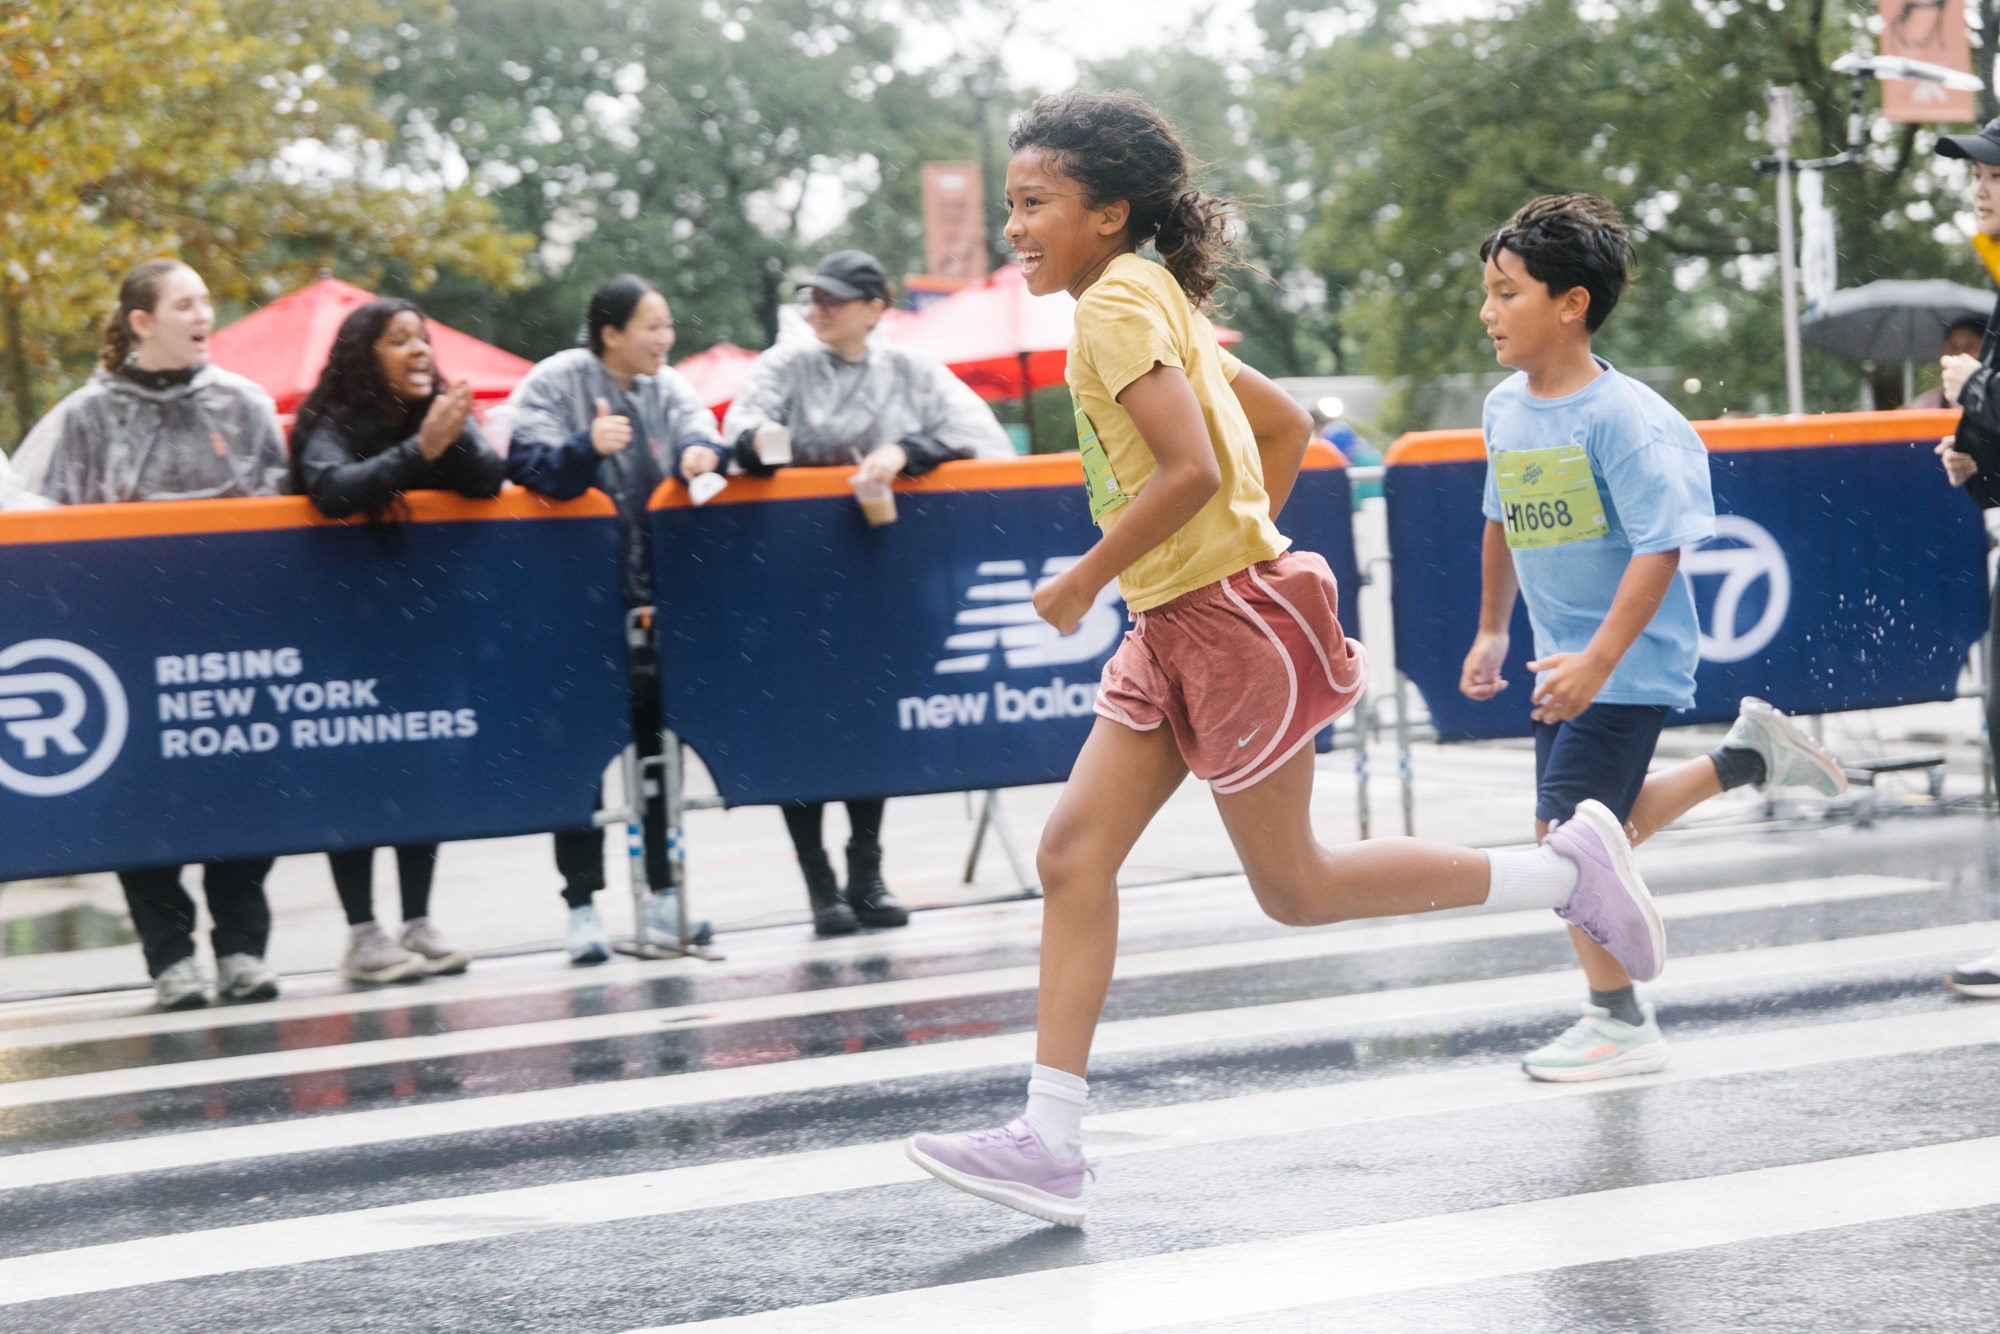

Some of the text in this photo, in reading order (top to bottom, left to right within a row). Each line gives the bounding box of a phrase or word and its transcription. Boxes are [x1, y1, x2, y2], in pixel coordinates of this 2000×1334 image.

[1504, 499, 1573, 533] H1668
[155, 647, 303, 686] RISING
[158, 678, 379, 722] NEW YORK
[897, 692, 990, 731] new
[161, 708, 479, 758] ROAD RUNNERS
